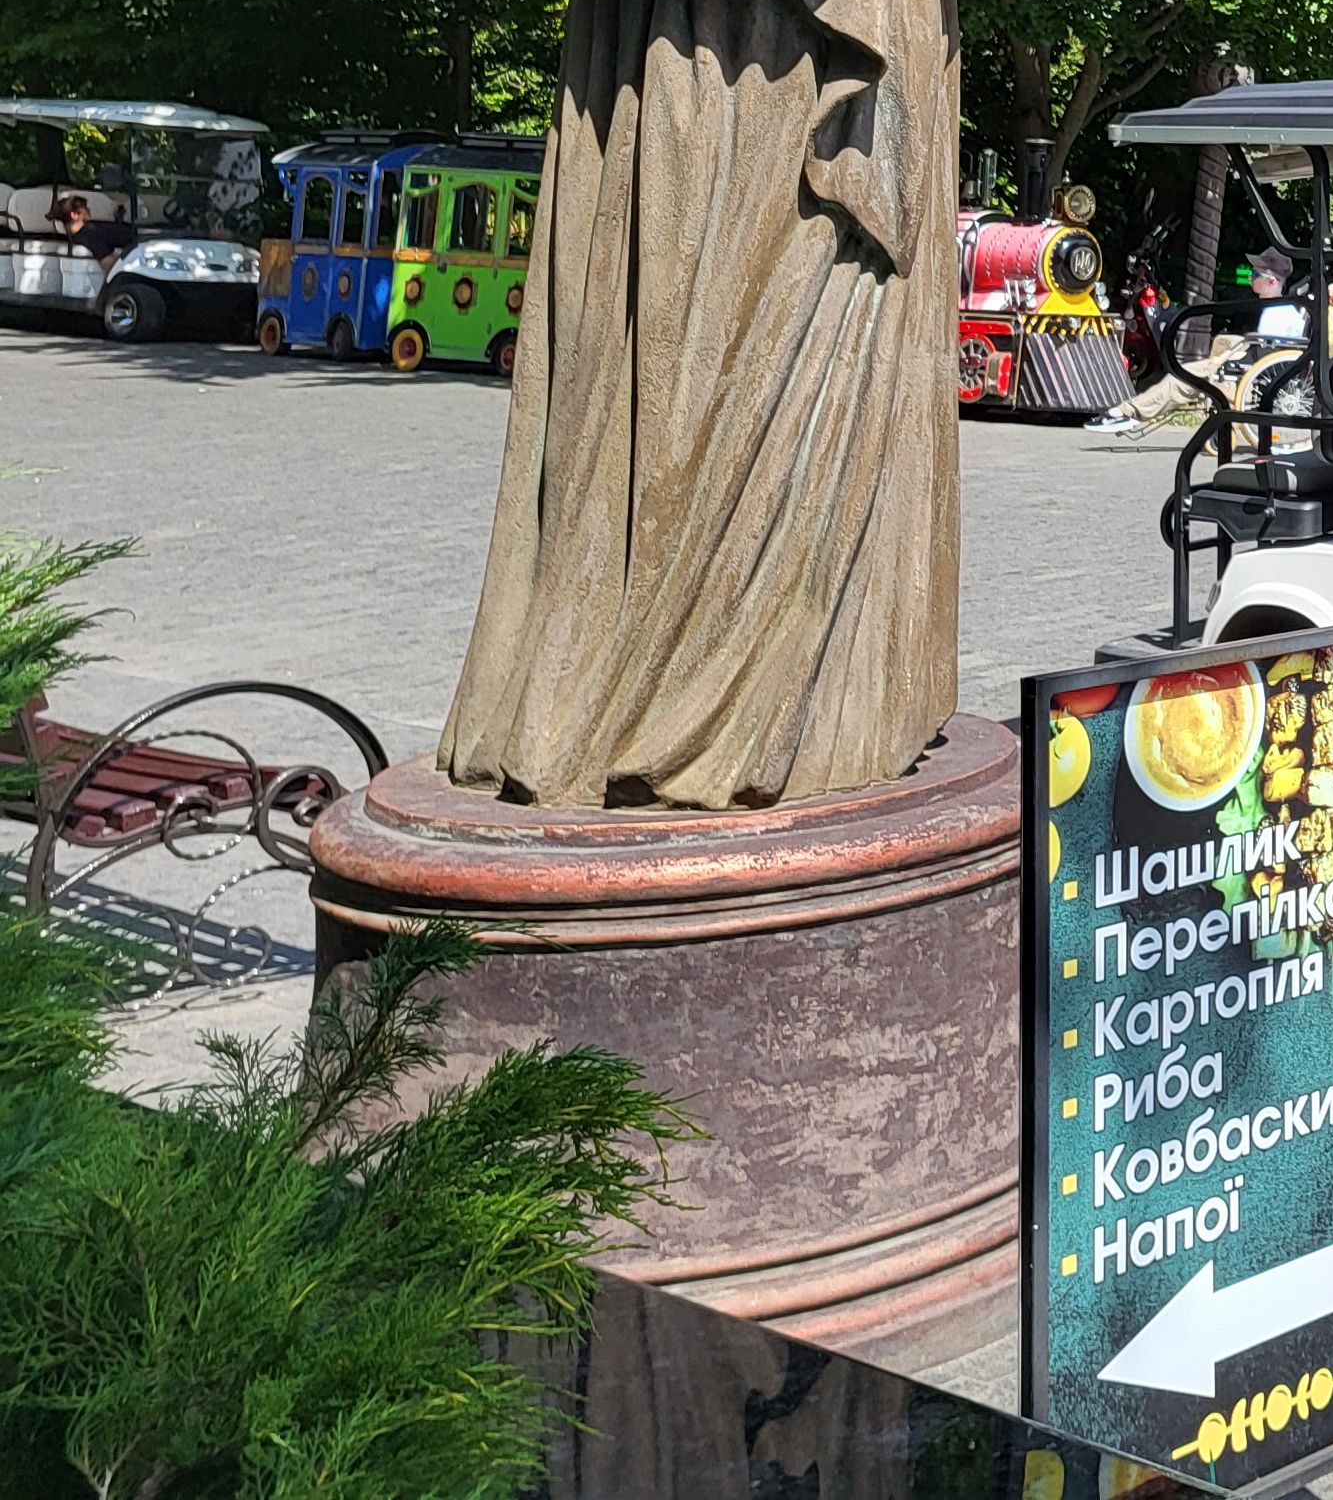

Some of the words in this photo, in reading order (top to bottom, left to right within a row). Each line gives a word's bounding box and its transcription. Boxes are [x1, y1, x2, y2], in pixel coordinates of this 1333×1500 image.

[1094, 820, 1302, 908] Шашлик
[1094, 952, 1324, 1057] Картопля
[1093, 1043, 1223, 1133] Риба
[1093, 1174, 1245, 1284] Напої
